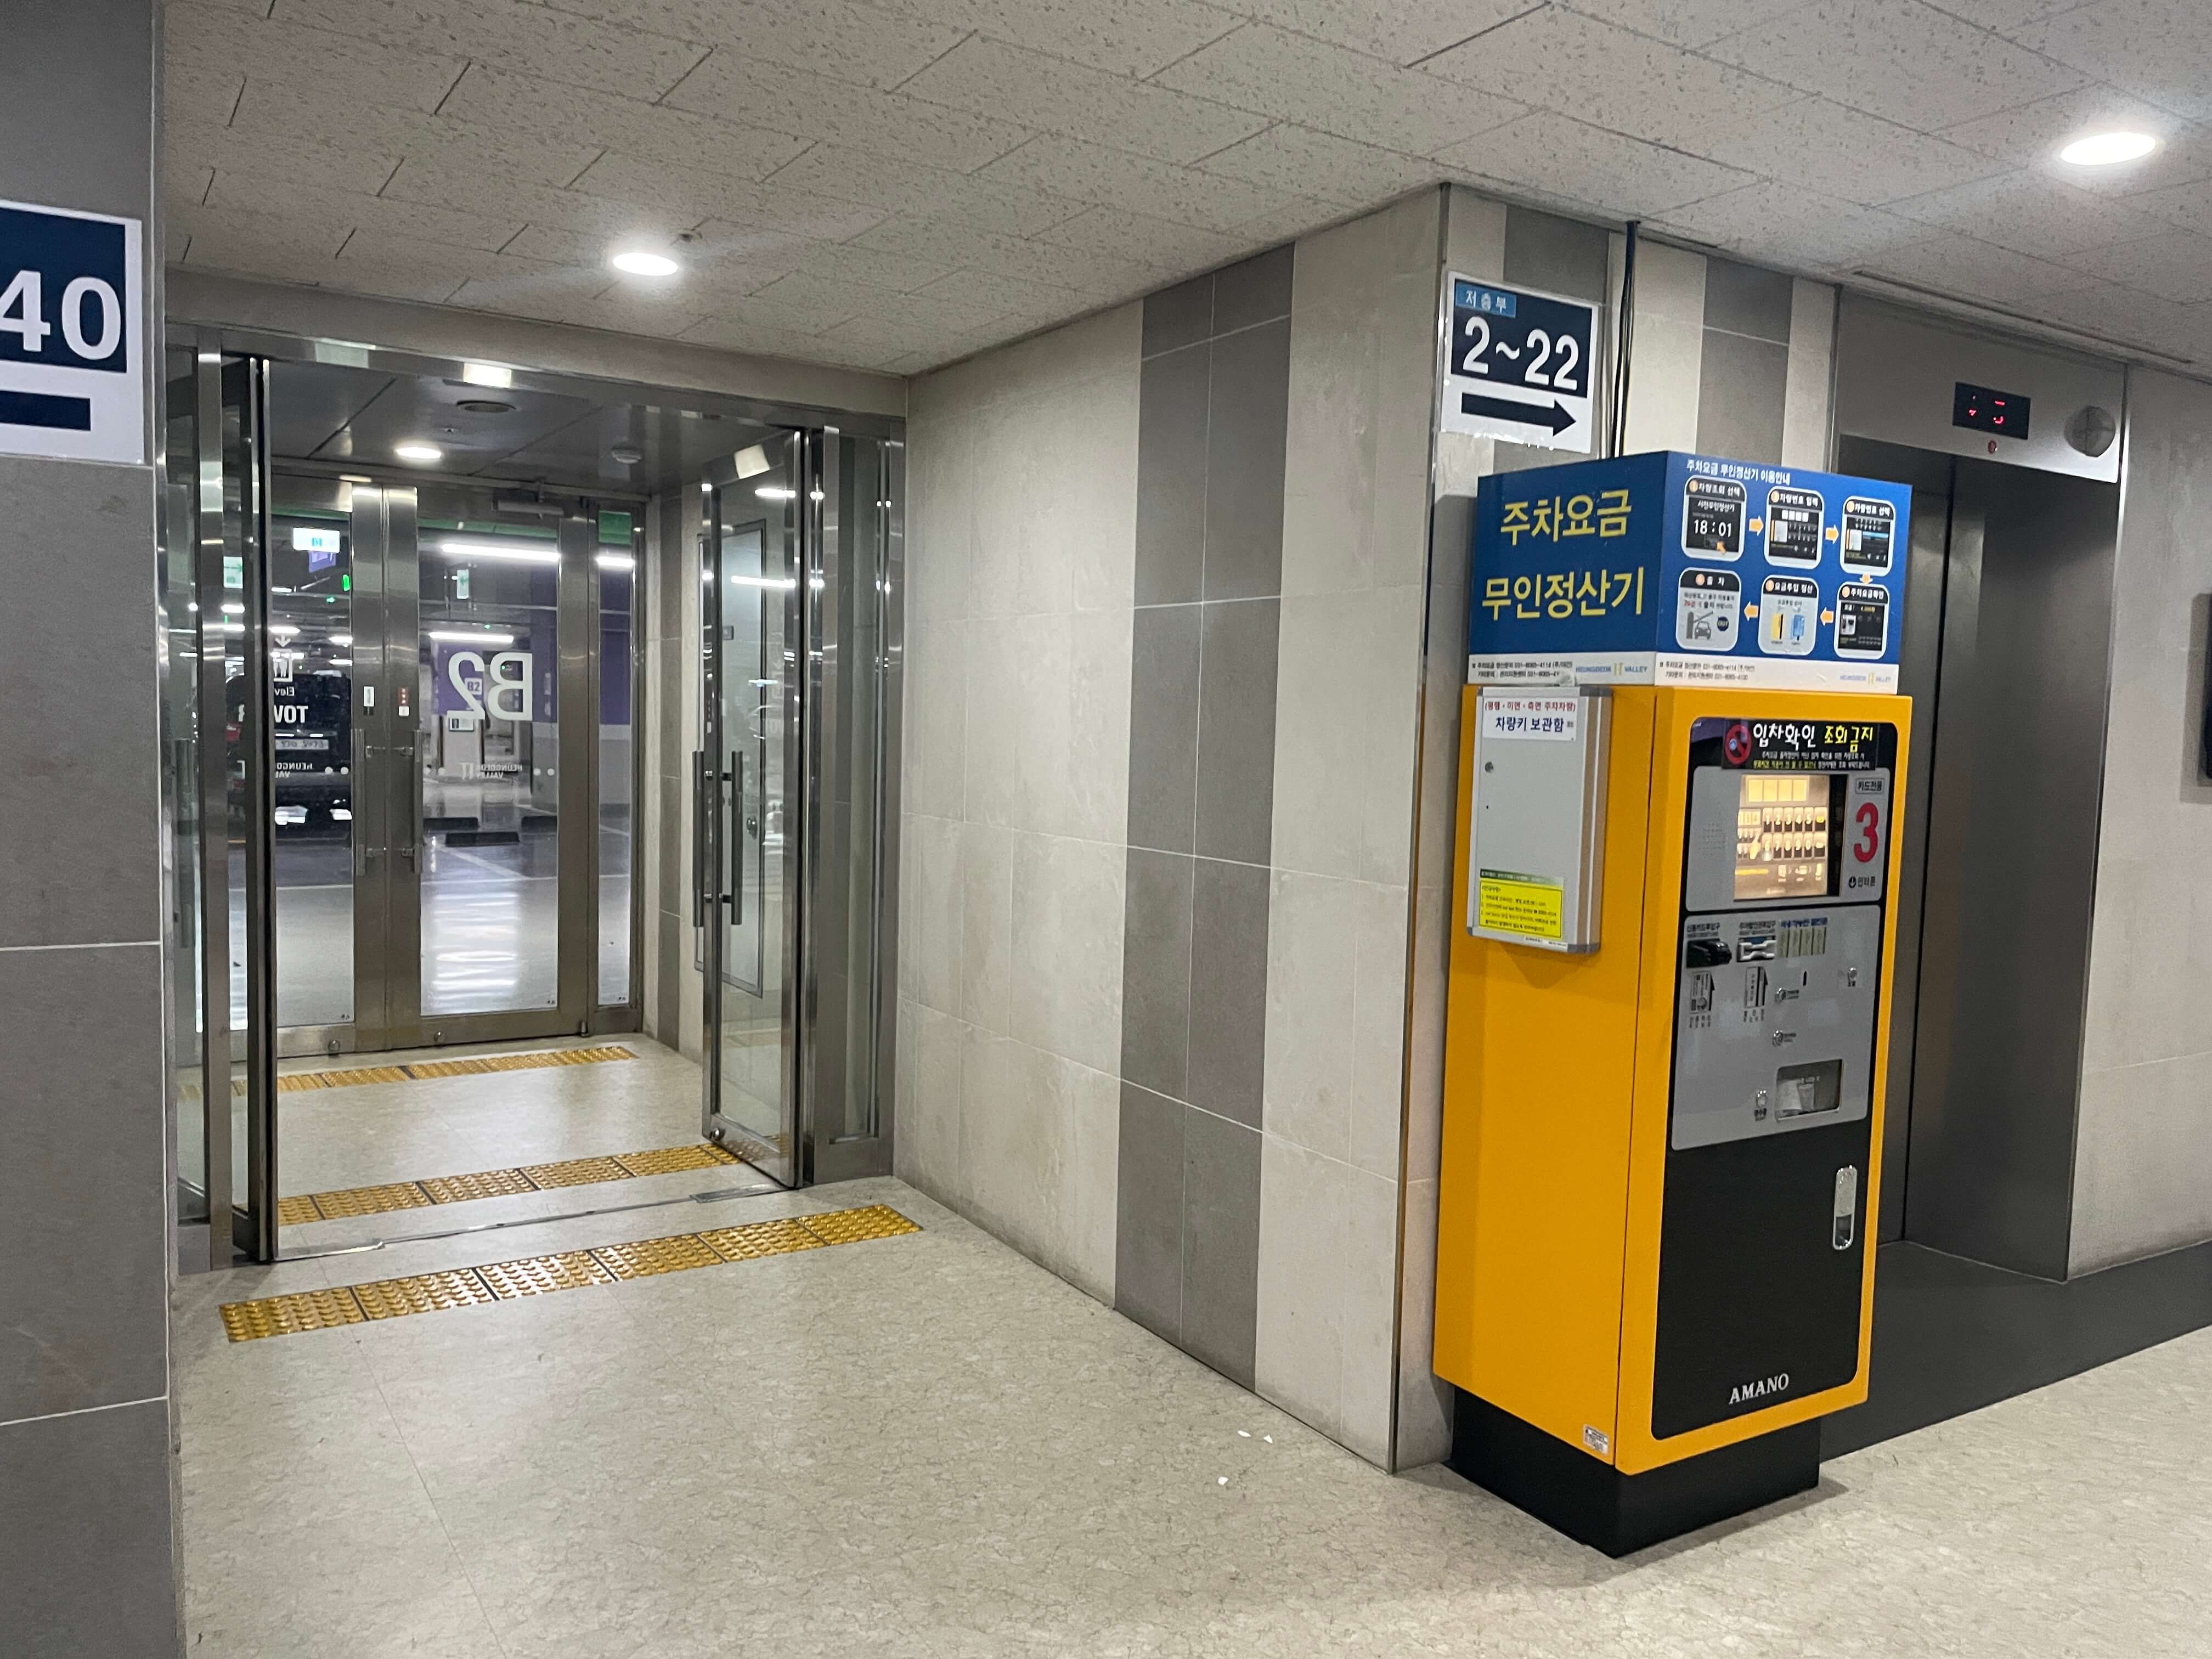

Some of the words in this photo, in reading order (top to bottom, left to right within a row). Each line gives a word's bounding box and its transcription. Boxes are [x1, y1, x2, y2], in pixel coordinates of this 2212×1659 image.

[0, 270, 121, 360] 40
[1462, 315, 1579, 391] 2~22
[1686, 459, 1718, 475] 주차요금
[1720, 464, 1759, 481] 무인정산기
[1760, 471, 1791, 486] 이용안내
[1500, 488, 1632, 546] 주차요금
[1482, 566, 1644, 621] 무인정산기
[1496, 716, 1527, 731] 차량키
[1530, 718, 1564, 733] 보관함
[1753, 723, 1816, 751] 입차확인
[1824, 725, 1874, 753] 조회금지
[1858, 781, 1882, 792] 카드전용
[1854, 802, 1879, 864] 3
[1729, 1373, 1790, 1405] AMANO
